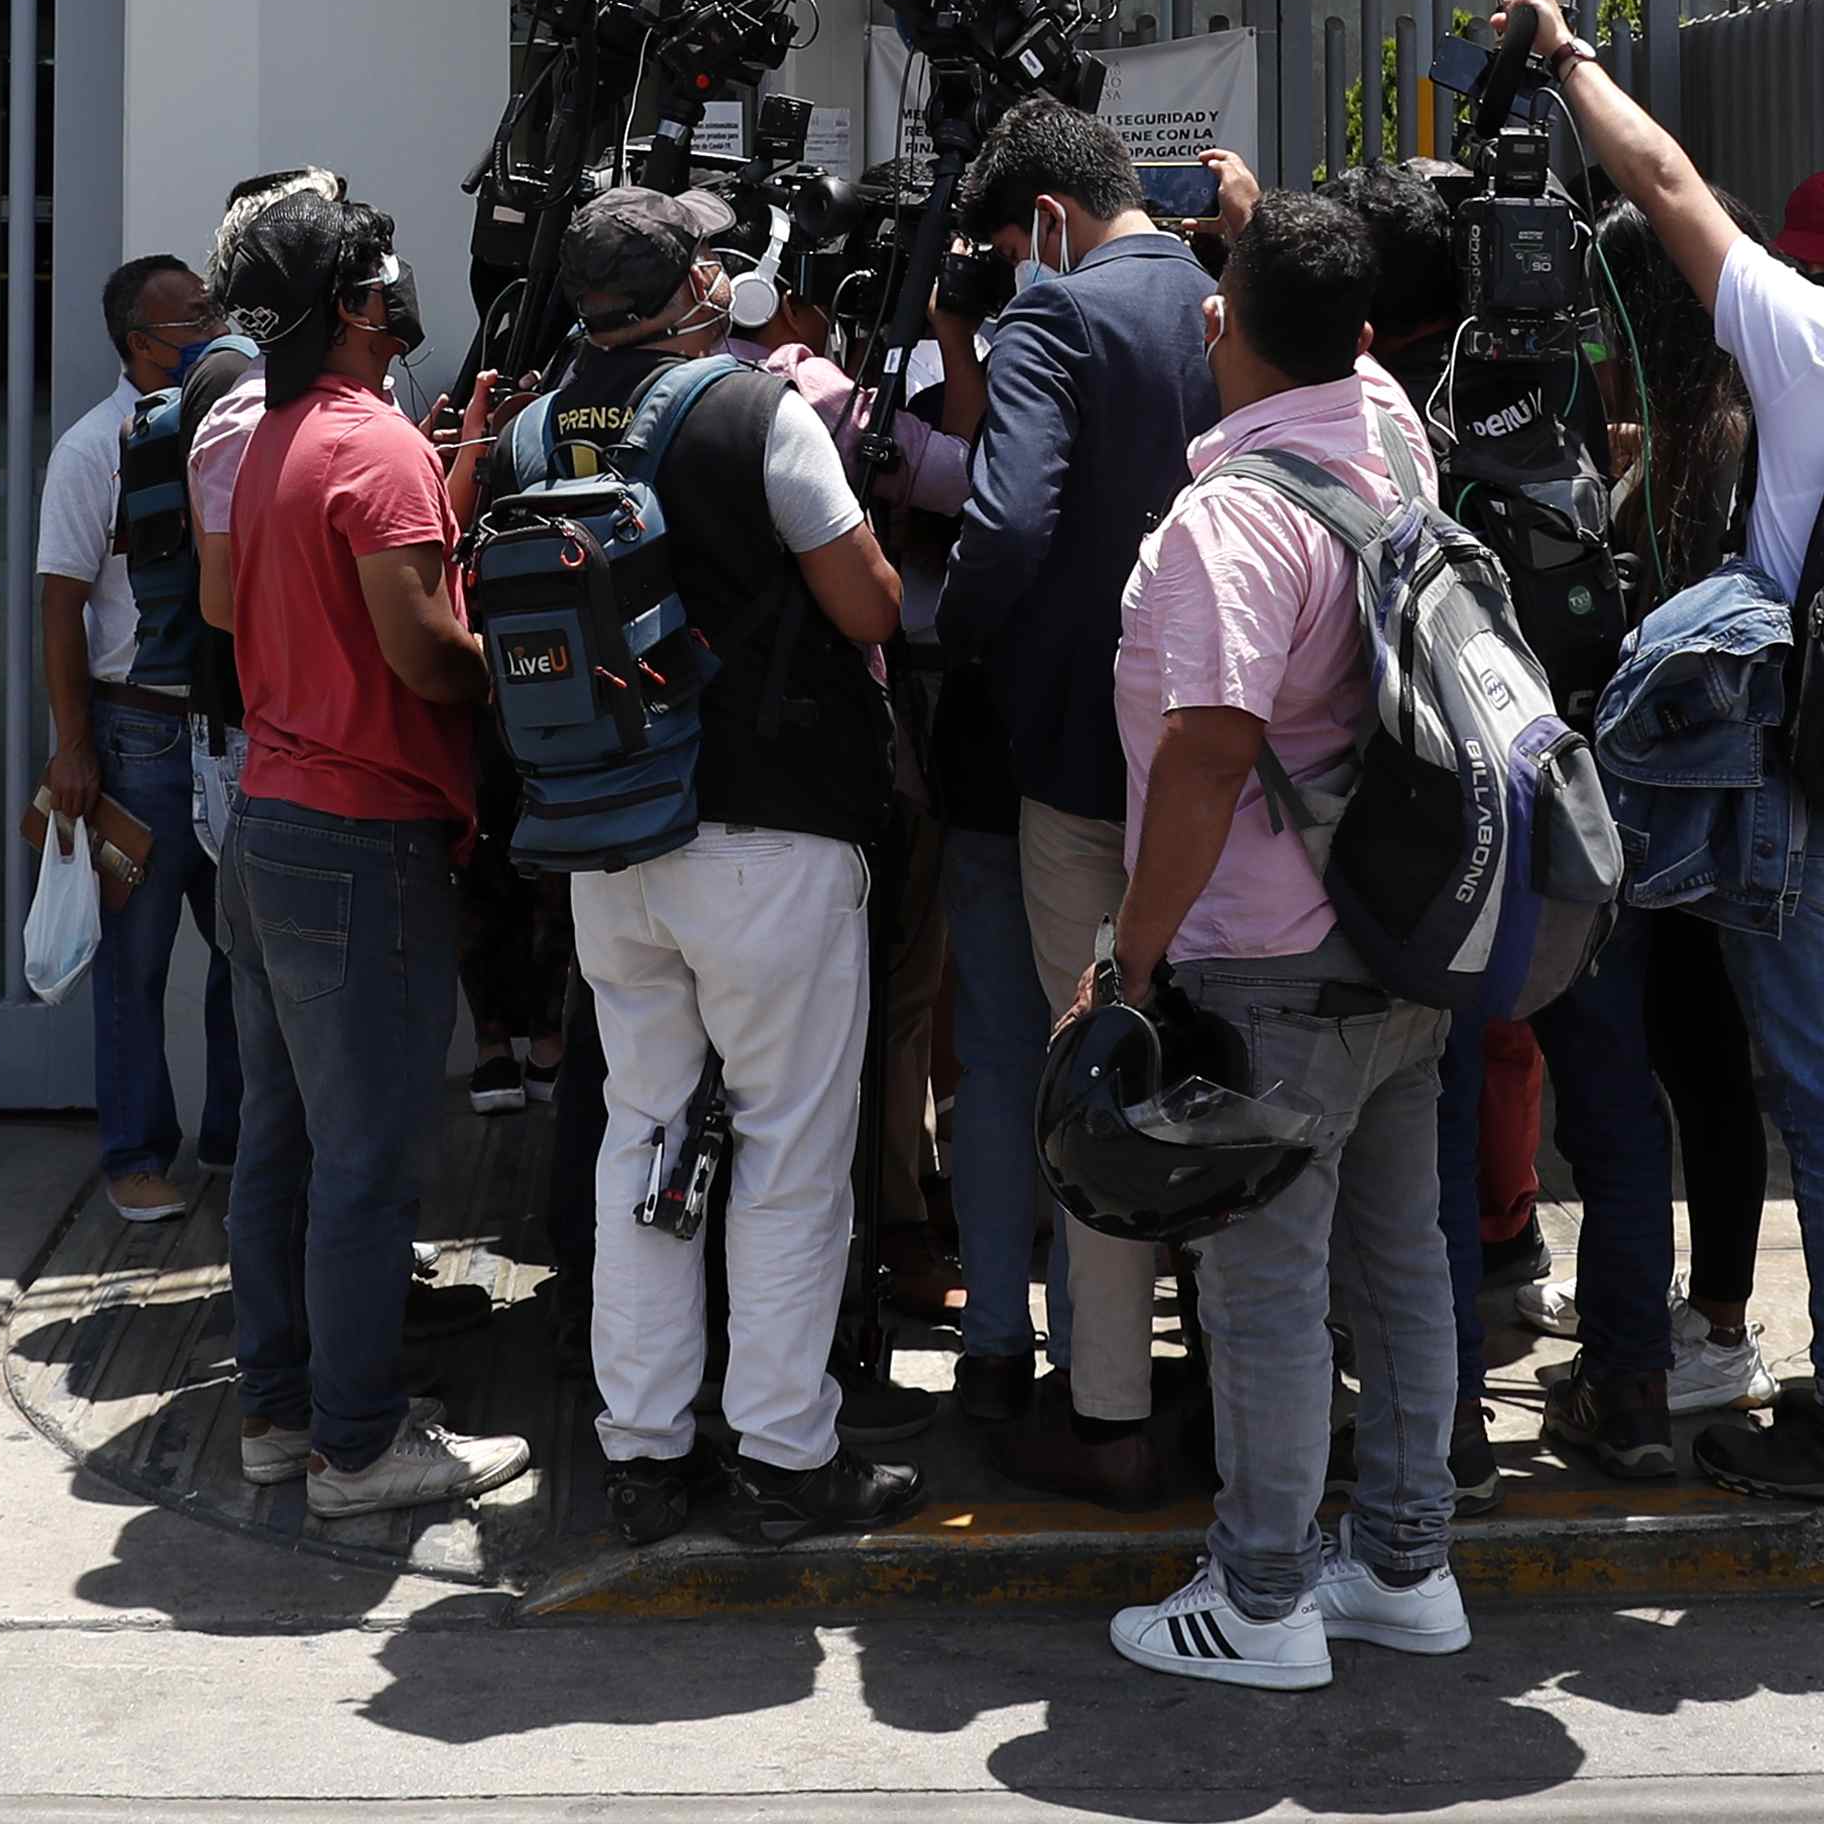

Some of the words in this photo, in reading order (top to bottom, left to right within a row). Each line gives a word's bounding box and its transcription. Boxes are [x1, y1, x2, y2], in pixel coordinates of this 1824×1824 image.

[1114, 112, 1206, 126] SEGURIDAD
[1208, 111, 1219, 122] Y
[1156, 129, 1190, 141] CON
[1194, 127, 1214, 139] LA
[557, 406, 636, 436] PRENSA
[1456, 739, 1494, 904] BILLABONG
